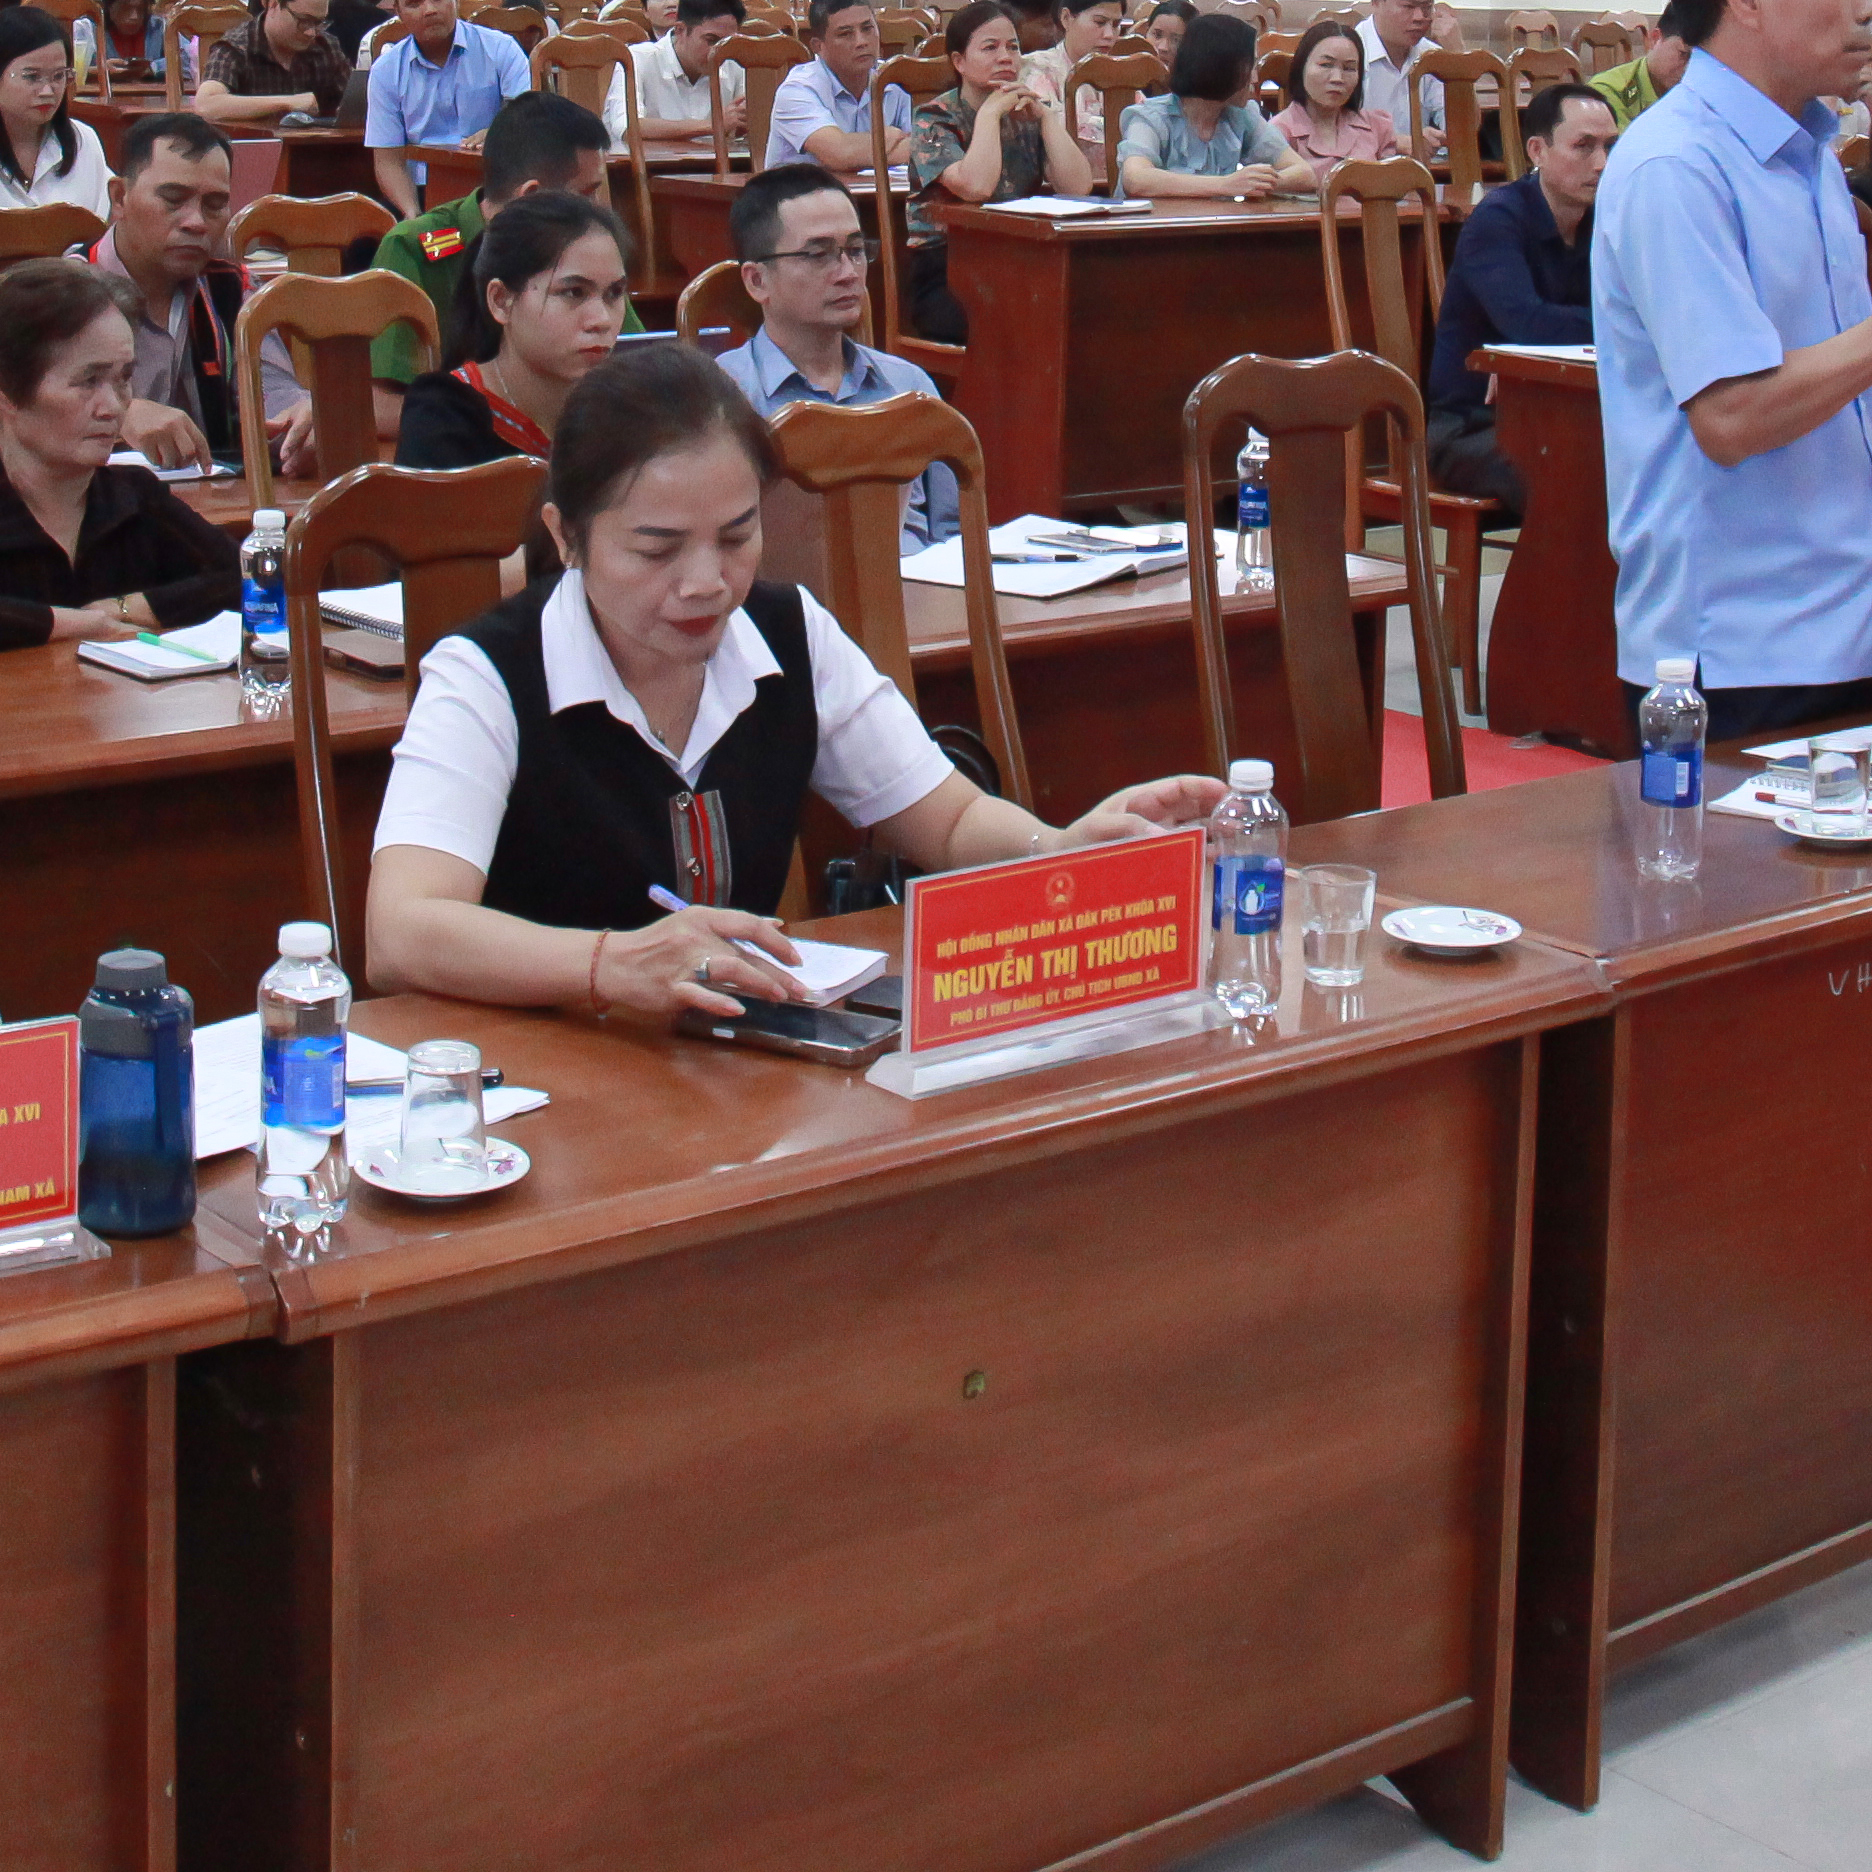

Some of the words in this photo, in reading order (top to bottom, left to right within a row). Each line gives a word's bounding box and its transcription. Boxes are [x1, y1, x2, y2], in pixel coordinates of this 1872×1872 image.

[933, 948, 1034, 1003] NGUYỄN
[1040, 944, 1078, 979] THỊ
[1084, 924, 1177, 969] THƯƠNG
[14, 1102, 41, 1124] XVI
[35, 1177, 56, 1198] XÃ
